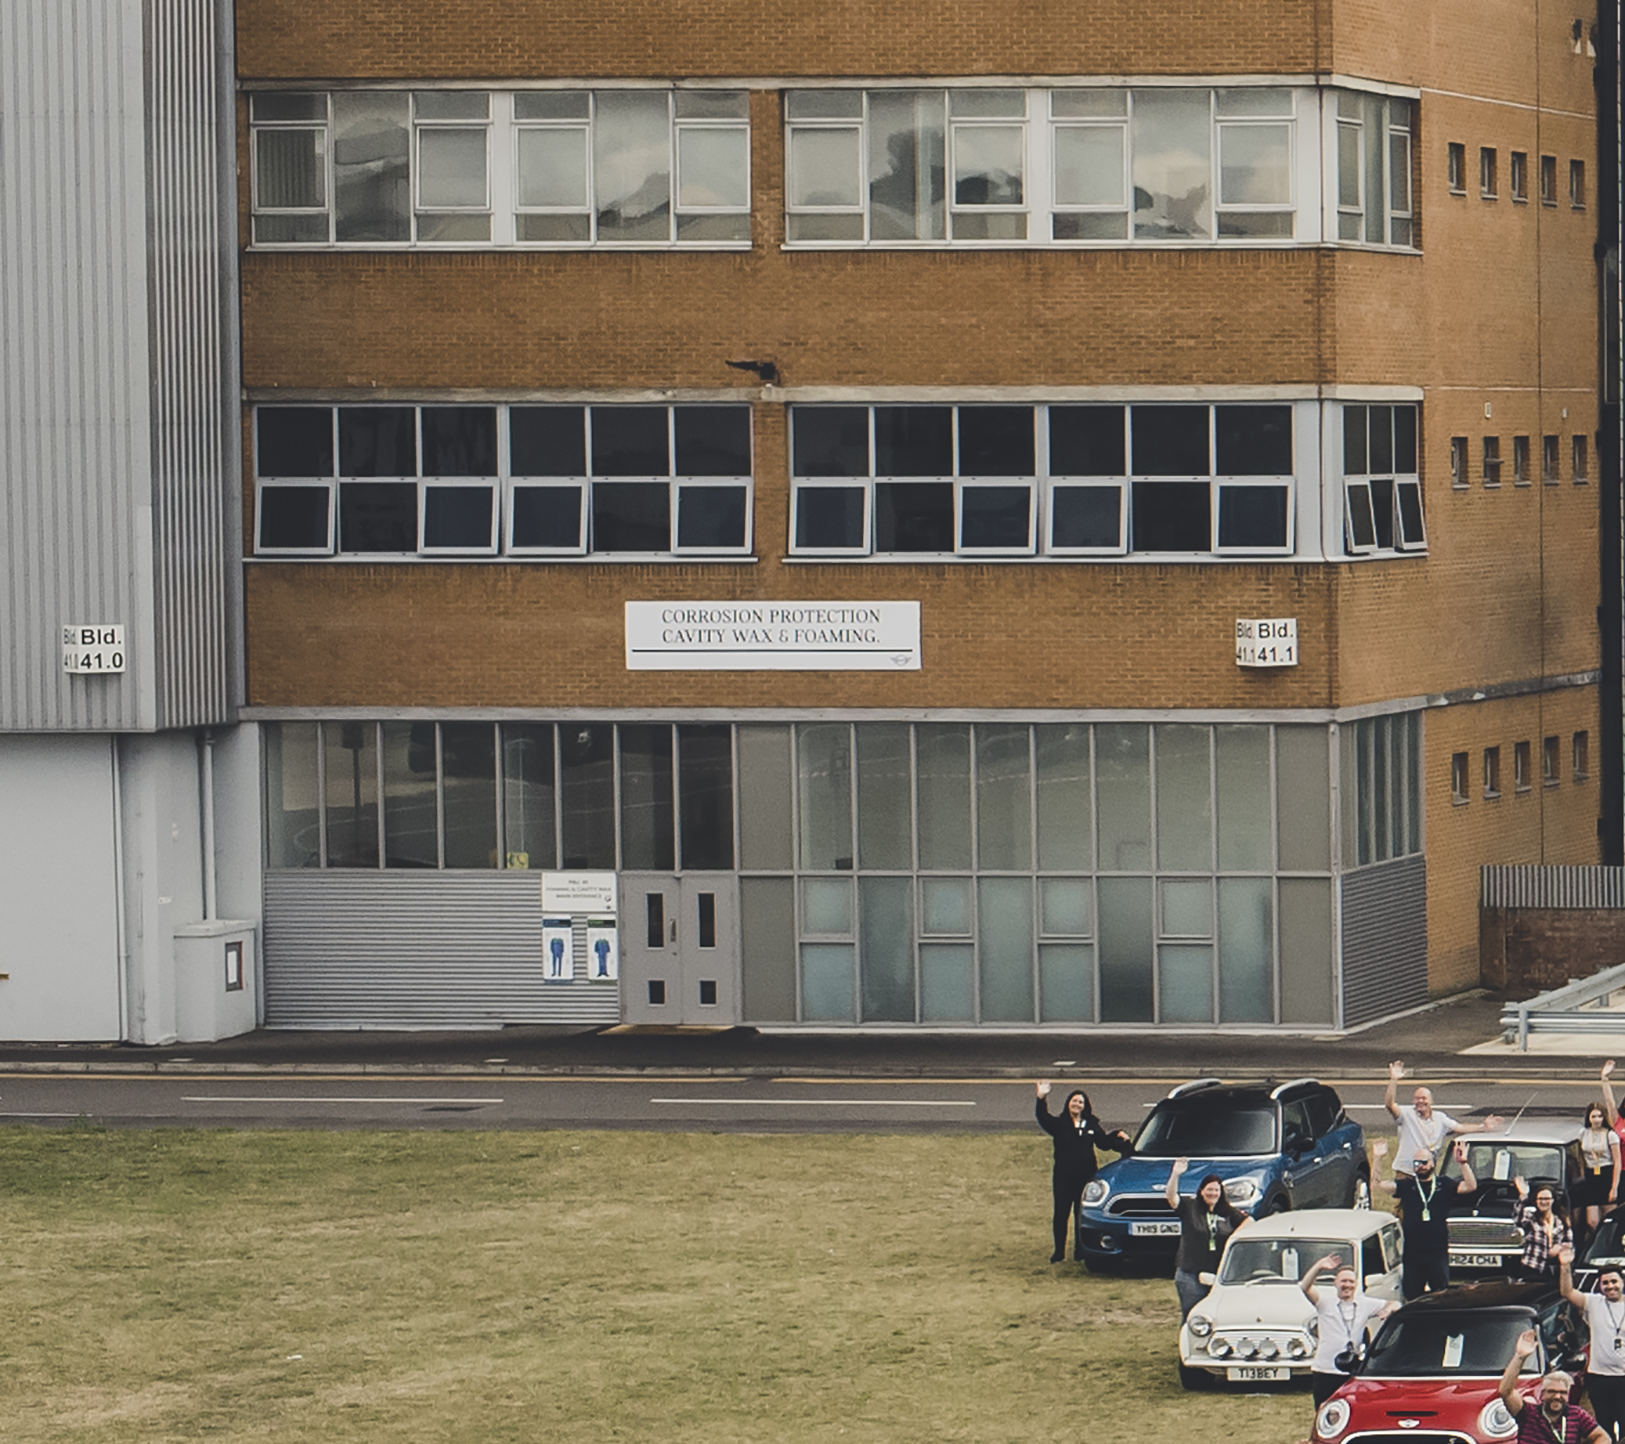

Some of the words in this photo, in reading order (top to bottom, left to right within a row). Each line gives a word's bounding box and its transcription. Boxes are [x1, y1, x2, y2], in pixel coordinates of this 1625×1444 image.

[661, 609, 764, 624] CORROSION
[769, 609, 880, 624] PROTECTION
[81, 628, 122, 645] Bld.
[661, 629, 725, 643] CAVITY
[731, 629, 774, 643] WAX
[794, 629, 880, 644] FOAMING.
[1258, 622, 1294, 638] Bld.
[81, 652, 123, 669] 41.0
[1257, 646, 1294, 662] 41.1
